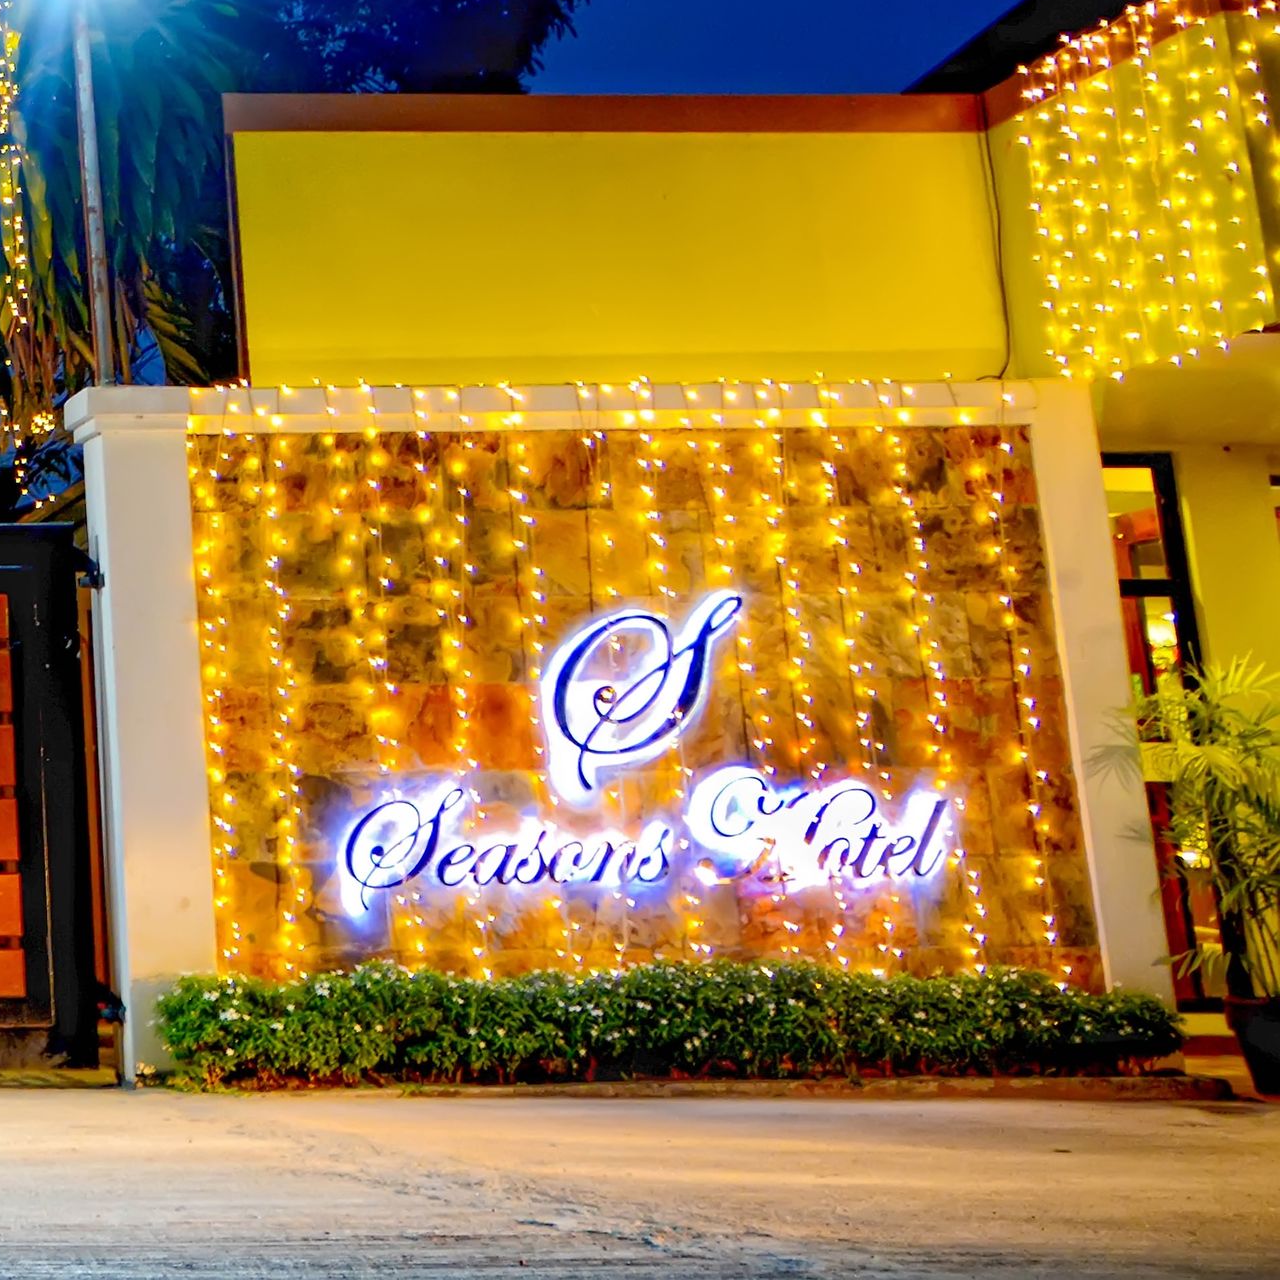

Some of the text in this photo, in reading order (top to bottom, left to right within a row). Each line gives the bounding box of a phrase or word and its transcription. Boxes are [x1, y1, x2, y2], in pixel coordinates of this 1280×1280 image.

[553, 595, 742, 791] S
[344, 774, 950, 911] Seasons Hotel
